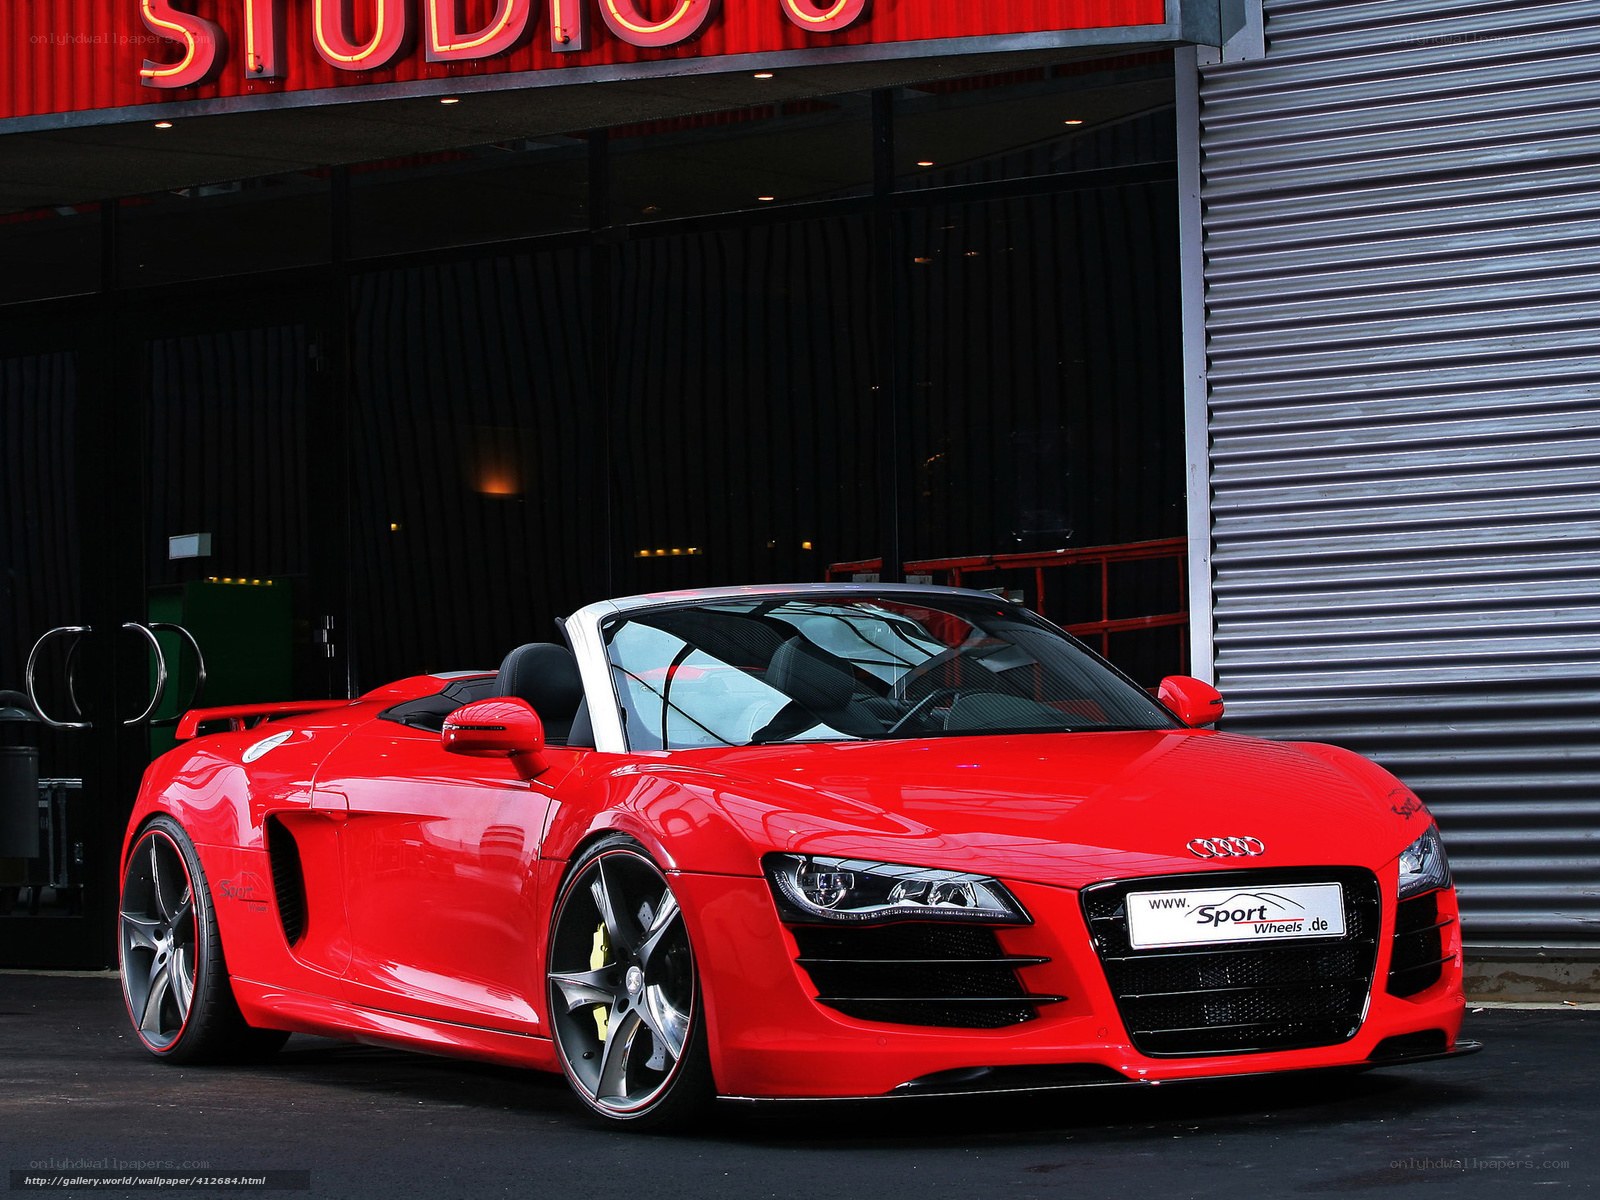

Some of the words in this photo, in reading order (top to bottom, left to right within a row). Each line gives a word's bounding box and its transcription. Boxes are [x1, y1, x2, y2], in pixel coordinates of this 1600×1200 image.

[1196, 905, 1268, 927] Sport
[1253, 922, 1303, 934] Wheels
[1307, 917, 1328, 931] .de
